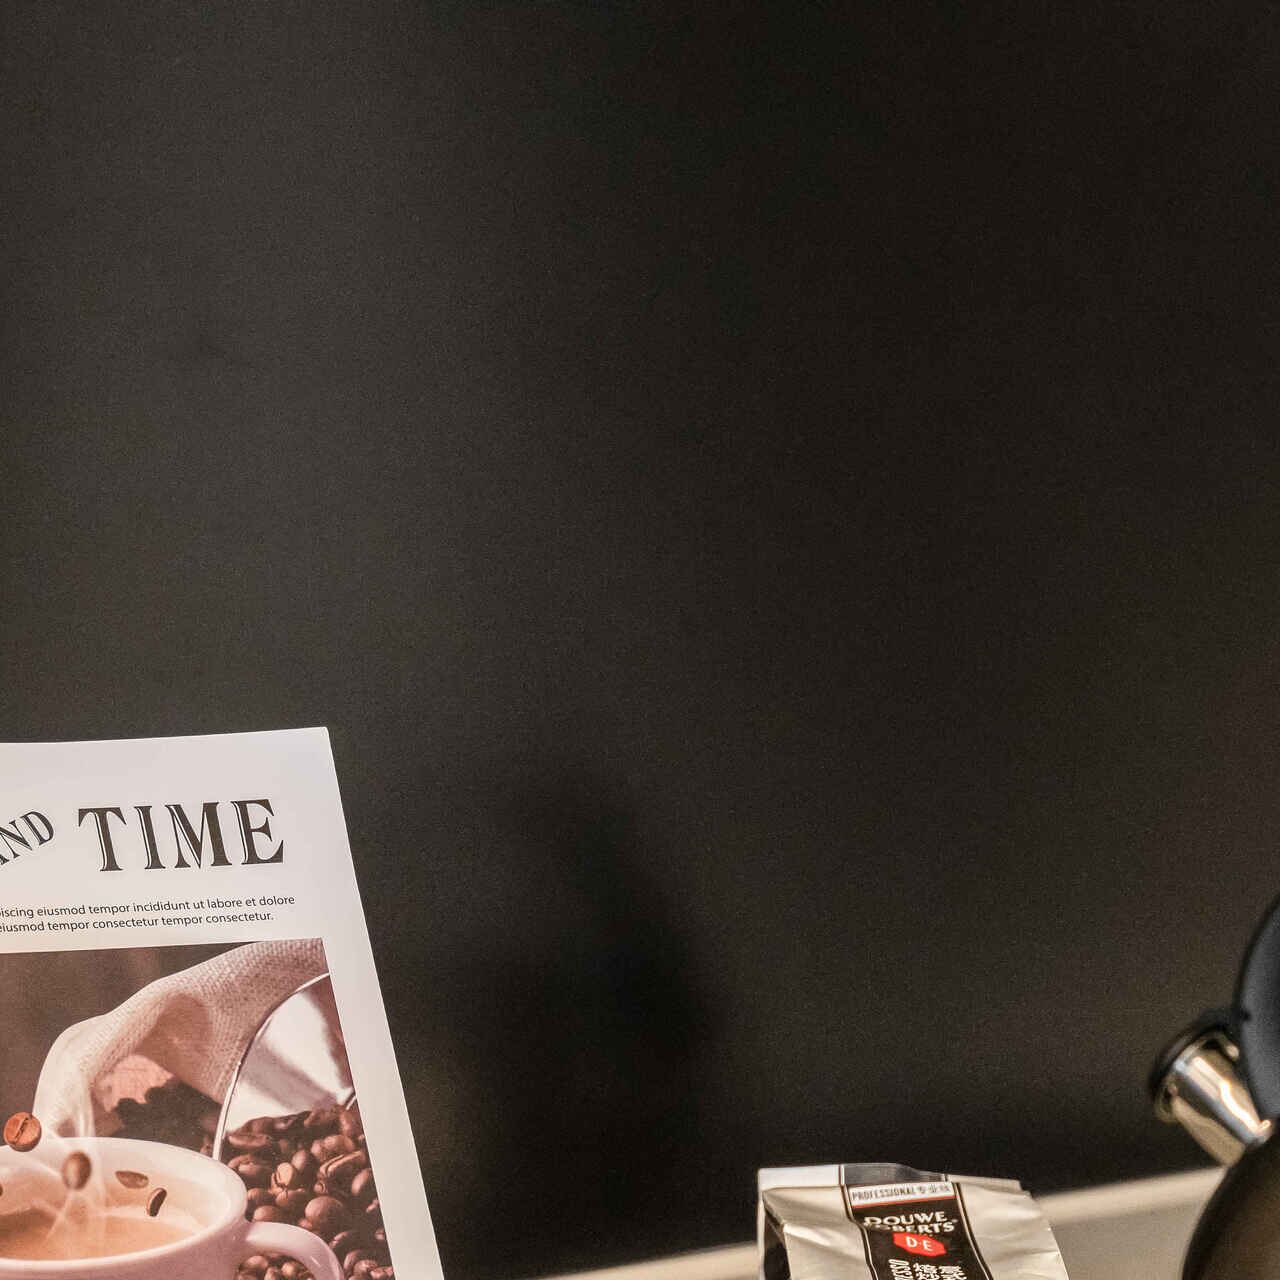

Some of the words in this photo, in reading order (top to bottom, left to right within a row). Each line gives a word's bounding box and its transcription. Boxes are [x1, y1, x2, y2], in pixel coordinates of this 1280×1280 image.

[76, 797, 286, 873] TIME
[37, 904, 86, 917] eiusmod
[88, 904, 131, 917] tempor
[133, 900, 191, 913] incididunt
[193, 900, 205, 910] ut
[207, 898, 243, 909] labore
[245, 897, 257, 908] et
[259, 895, 295, 907] dolore
[47, 919, 90, 934] tempor
[92, 917, 159, 930] consectetur
[161, 915, 203, 928] tempor
[206, 911, 275, 925] consectetur.
[863, 1211, 948, 1227] DOUWE
